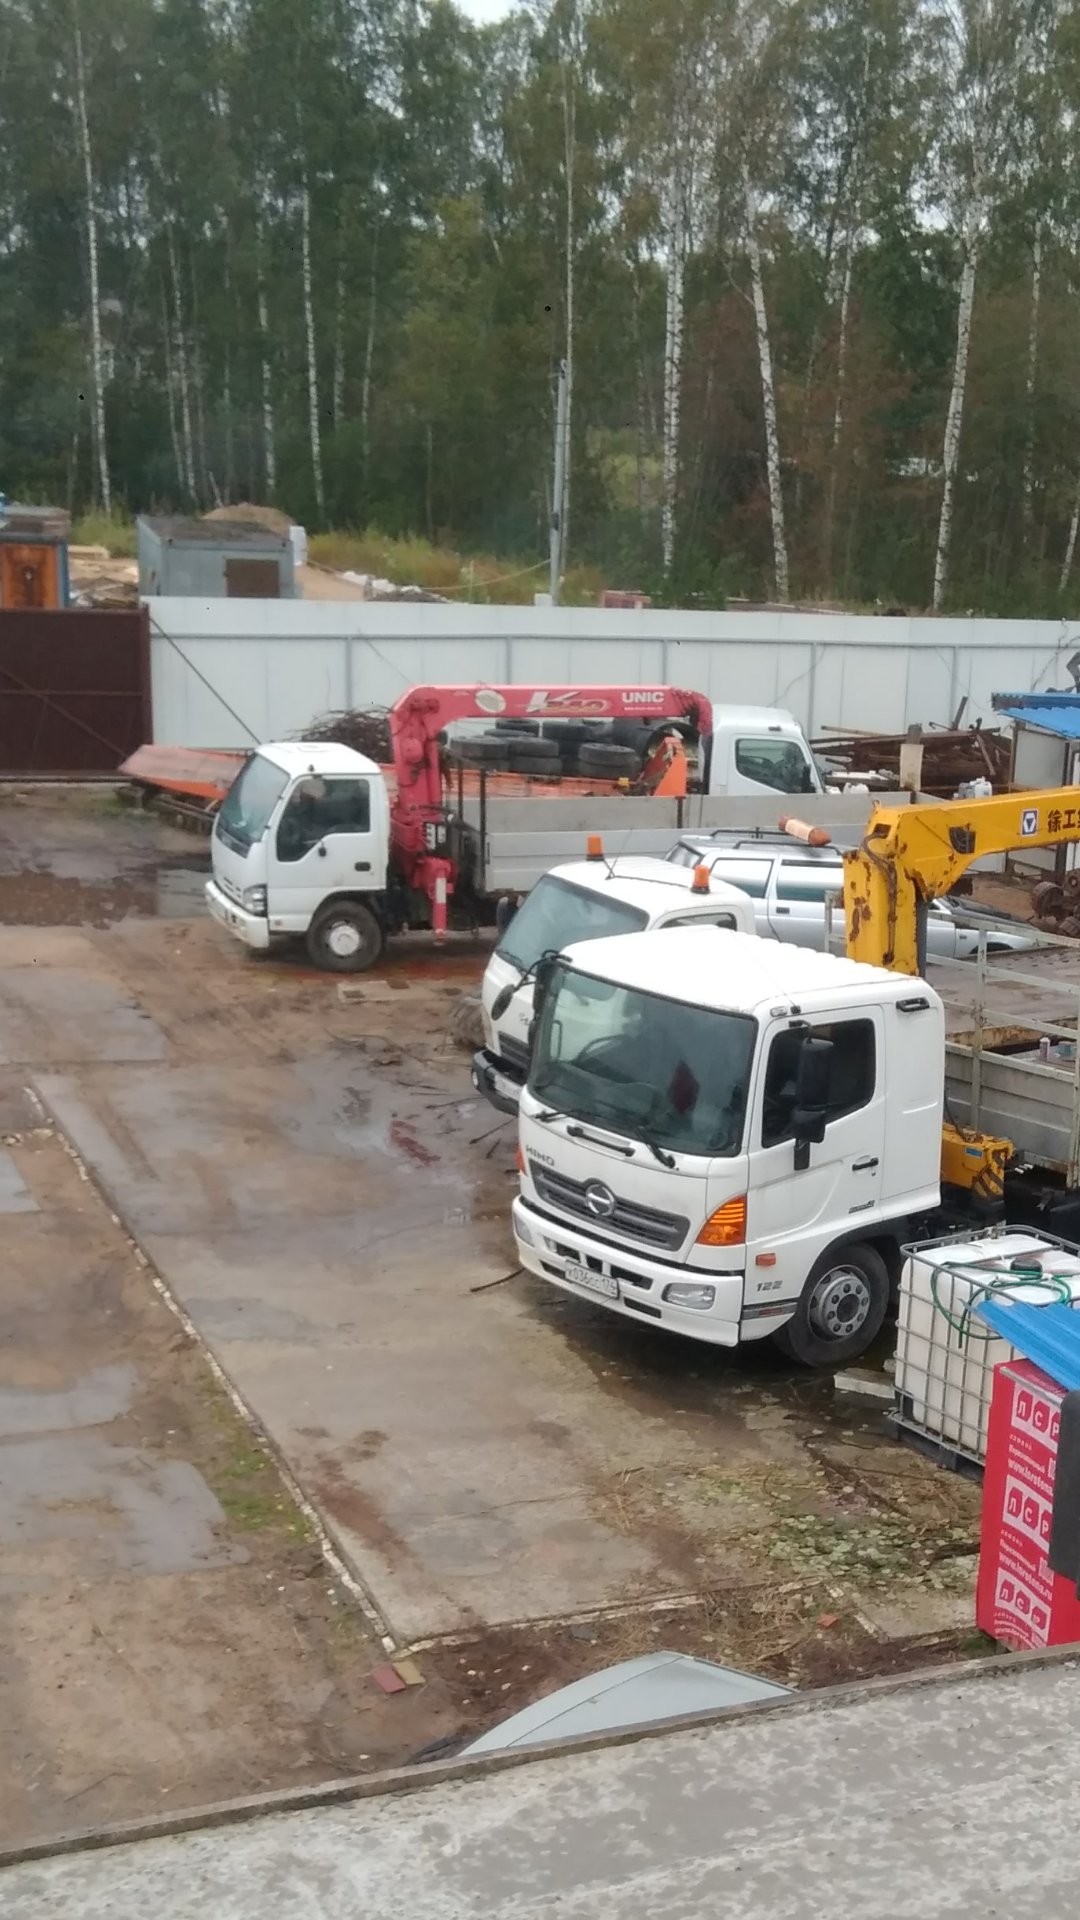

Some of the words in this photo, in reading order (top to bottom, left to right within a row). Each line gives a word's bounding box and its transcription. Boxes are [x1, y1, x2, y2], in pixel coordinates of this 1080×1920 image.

[622, 692, 664, 703] UNIC
[1047, 808, 1080, 833] 徐工
[526, 1145, 555, 1166] HINO
[757, 1281, 782, 1291] 122
[1017, 1400, 1060, 1437] ЛСР
[1008, 1500, 1049, 1535] ЛСР
